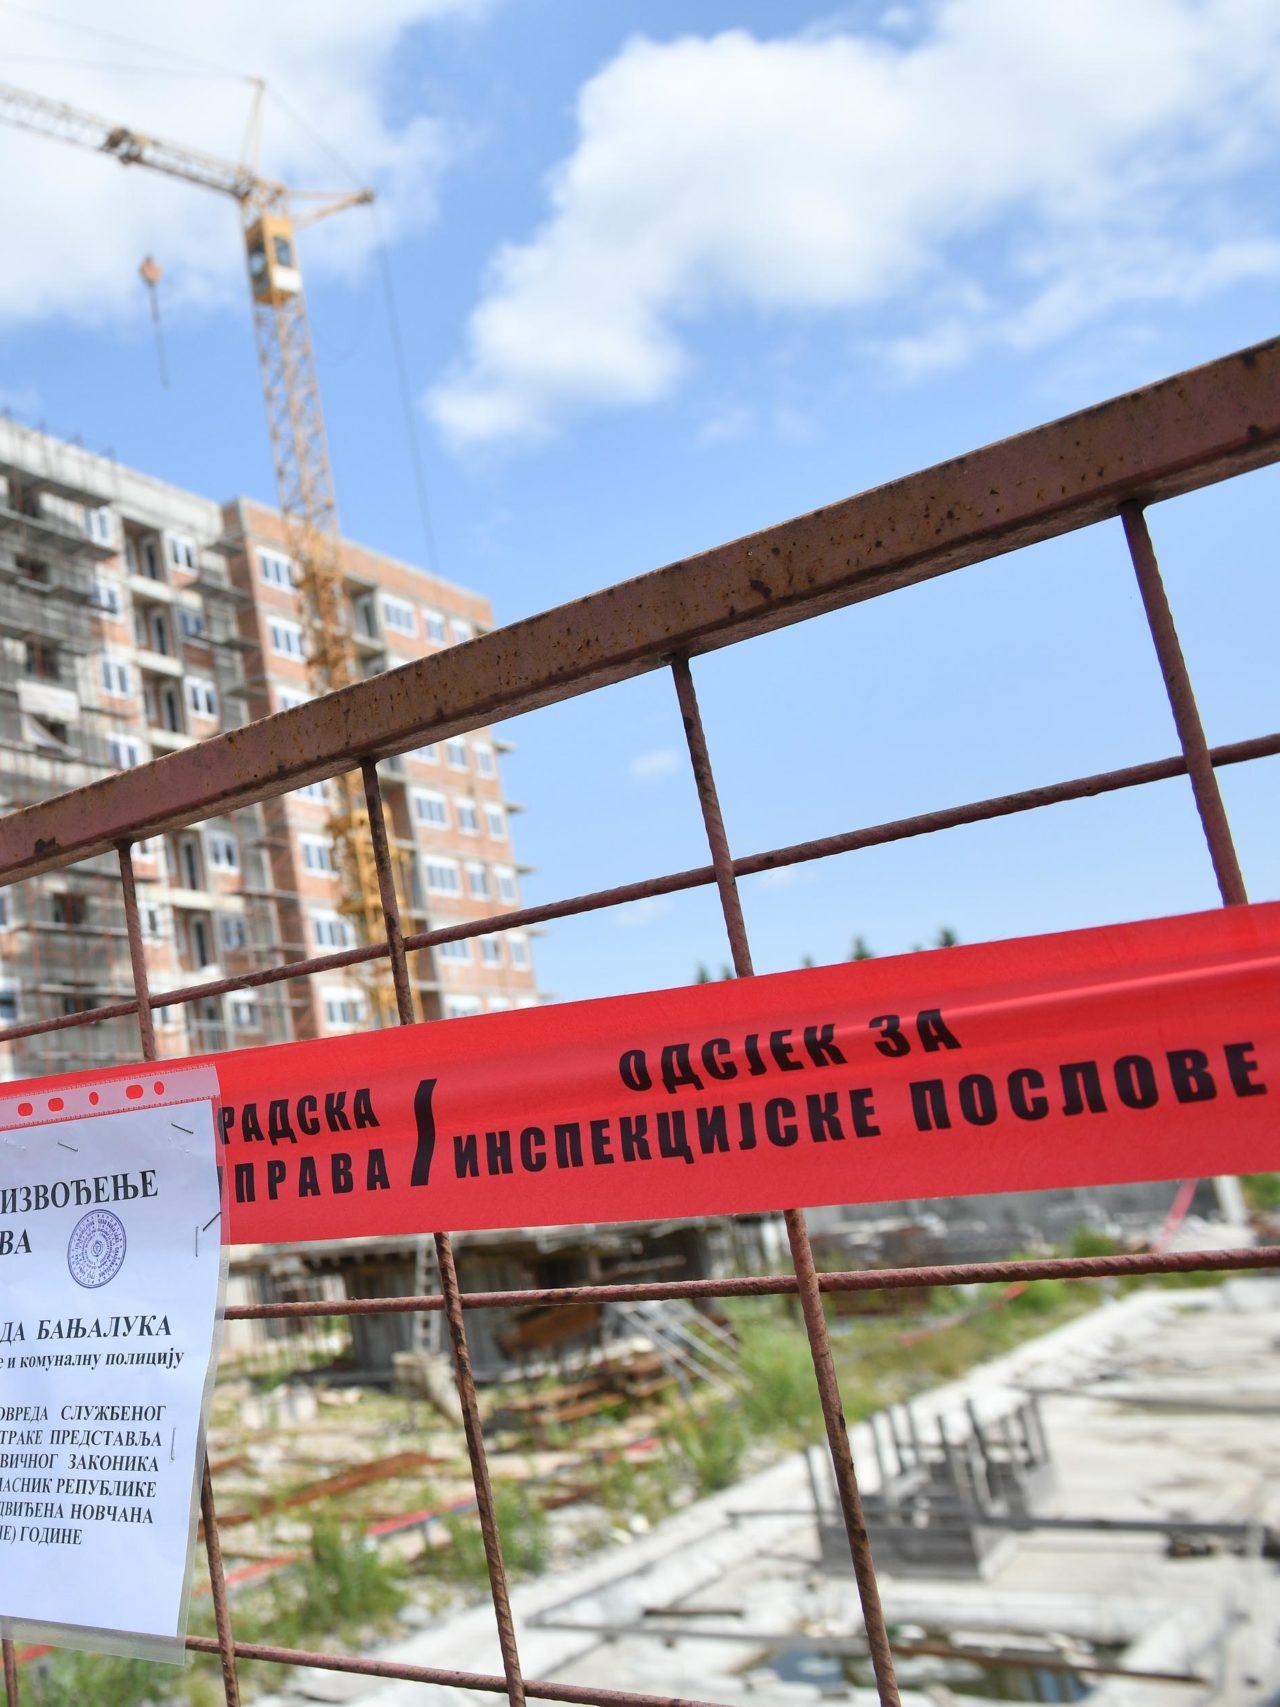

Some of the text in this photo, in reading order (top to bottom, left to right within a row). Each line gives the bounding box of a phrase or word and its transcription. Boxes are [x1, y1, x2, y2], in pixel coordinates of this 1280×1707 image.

[620, 1009, 962, 1094] ОДСЈЕК ЗА
[217, 1088, 380, 1146] РАДСКА
[454, 1041, 1267, 1178] ИНСПЕКЦИЈСКЕ ПОСЛОВЕ
[217, 1148, 391, 1203] ПРАВА
[0, 1169, 159, 1216] ИЗВОЂЕЊЕ
[37, 1315, 171, 1340] БАЊАЛУКА
[7, 1357, 16, 1370] и
[20, 1353, 101, 1371] комуналну
[105, 1348, 184, 1370] полицију
[61, 1405, 166, 1421] СЛУЖБЕНОГ
[0, 1430, 43, 1445] ТРАКЕ
[49, 1430, 162, 1448] ПРЕДСТАВЉА
[67, 1454, 159, 1472] ЗАКОНИКА
[56, 1478, 157, 1498] РЕПУБЛИКЕ
[70, 1503, 154, 1524] НОВЧАНА
[20, 1526, 83, 1546] ГОДИНЕ
